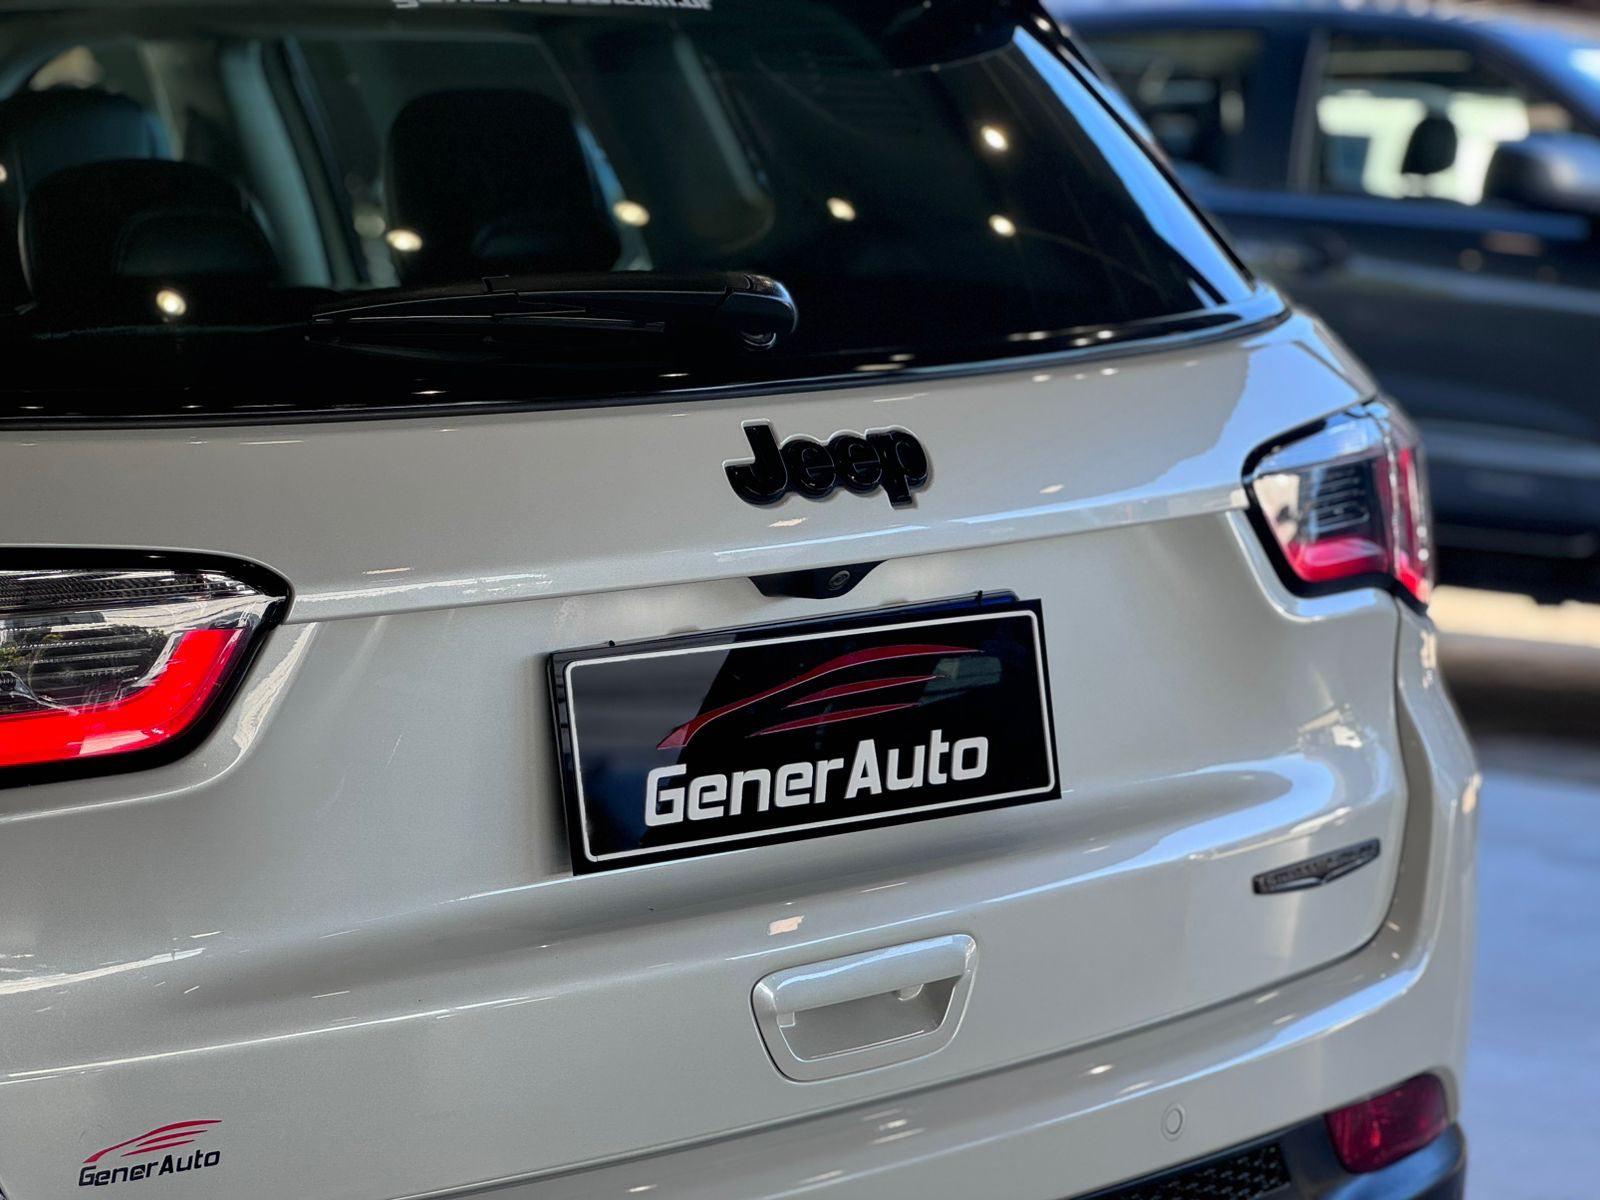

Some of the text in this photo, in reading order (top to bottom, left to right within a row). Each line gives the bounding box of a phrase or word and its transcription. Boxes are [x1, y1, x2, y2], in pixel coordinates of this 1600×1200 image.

[722, 418, 929, 509] Jeep
[643, 728, 989, 828] GenerAuto
[78, 1149, 221, 1187] GenerAuto
